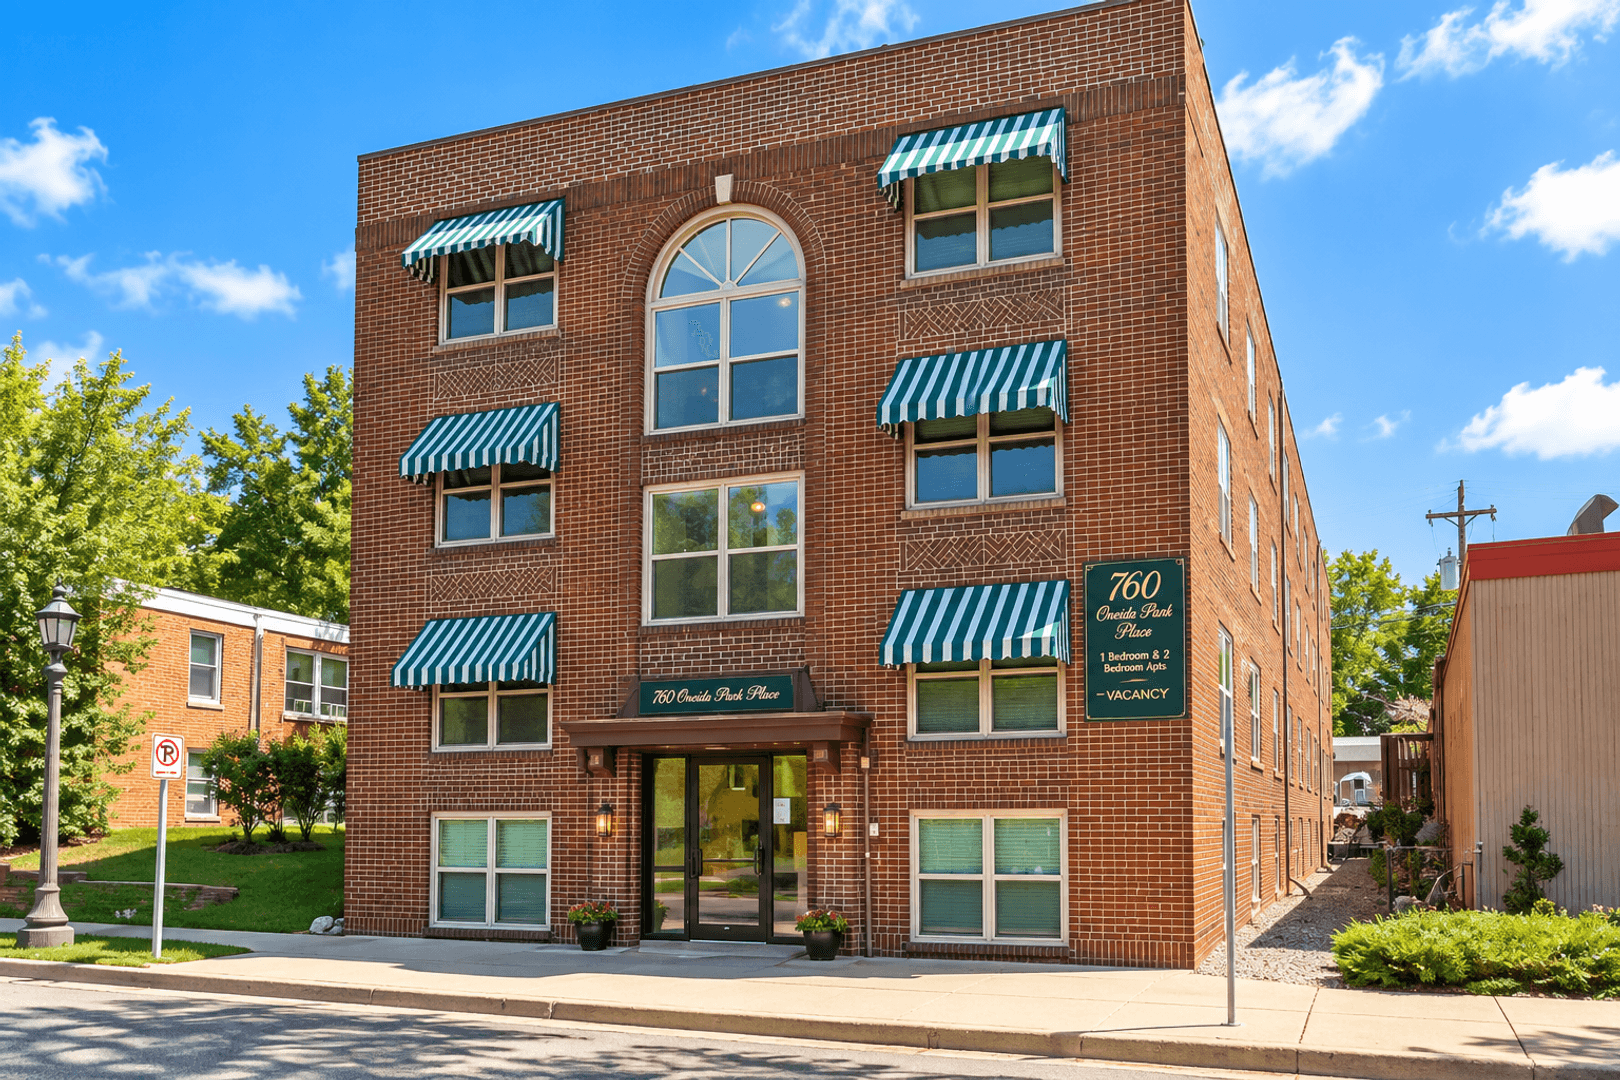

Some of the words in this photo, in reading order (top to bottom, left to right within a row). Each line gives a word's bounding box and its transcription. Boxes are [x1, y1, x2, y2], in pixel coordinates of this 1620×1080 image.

[1108, 570, 1162, 602] 760
[1096, 605, 1137, 622] Oneida
[1114, 622, 1153, 640] Place
[1100, 652, 1105, 662] 1
[1108, 651, 1149, 662] Bedroom
[1152, 649, 1160, 660] &
[1163, 649, 1170, 660] 2
[1104, 662, 1144, 673] Bedroom
[652, 689, 676, 705] 760
